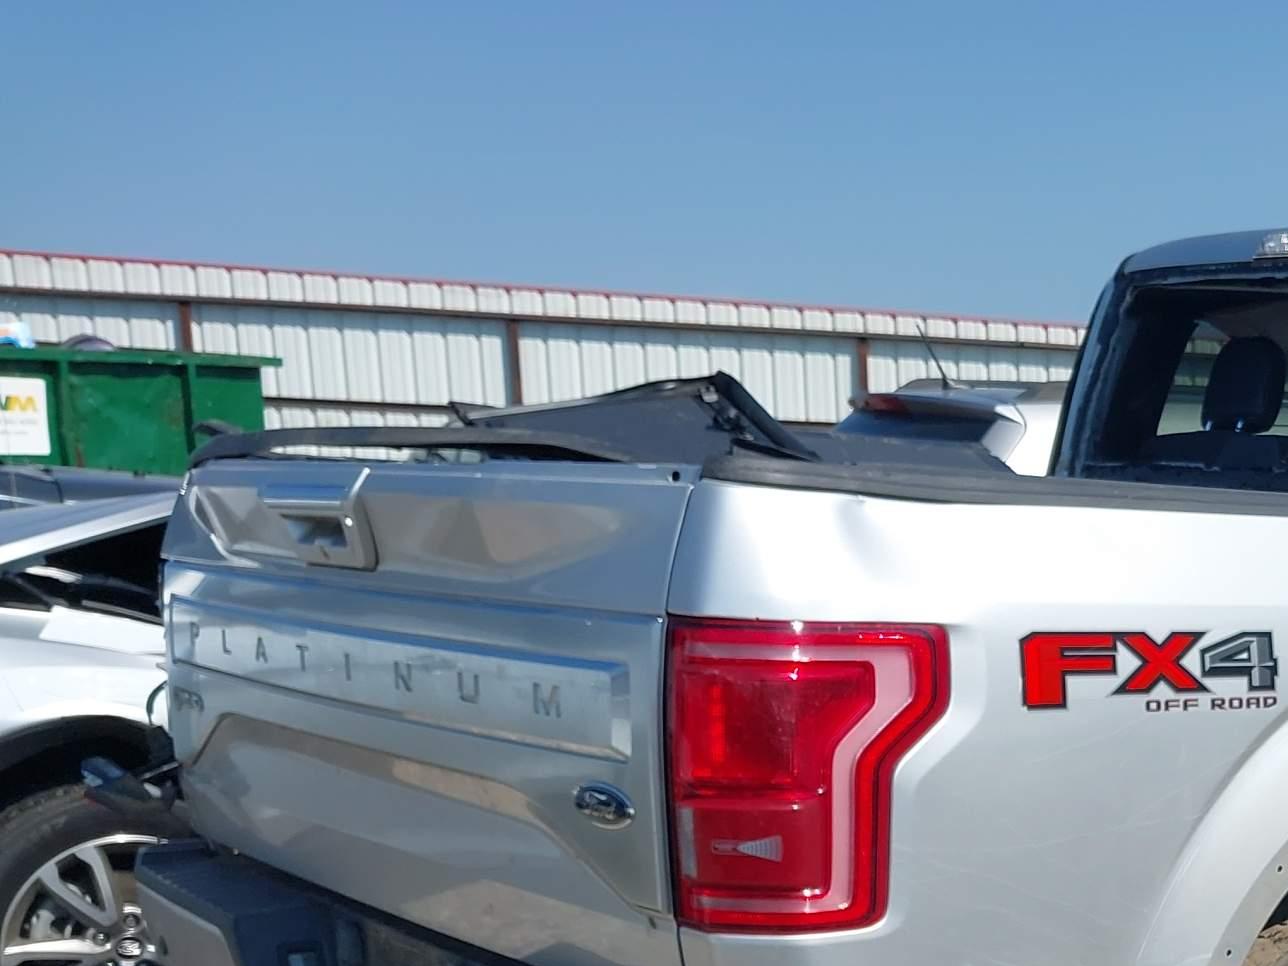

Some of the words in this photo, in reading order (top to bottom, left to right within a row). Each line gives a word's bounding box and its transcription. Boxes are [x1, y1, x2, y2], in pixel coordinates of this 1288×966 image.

[189, 621, 562, 719] PLATINUM
[1019, 631, 1278, 710] FX4
[1145, 697, 1200, 712] OFF
[1210, 695, 1278, 711] ROAD
